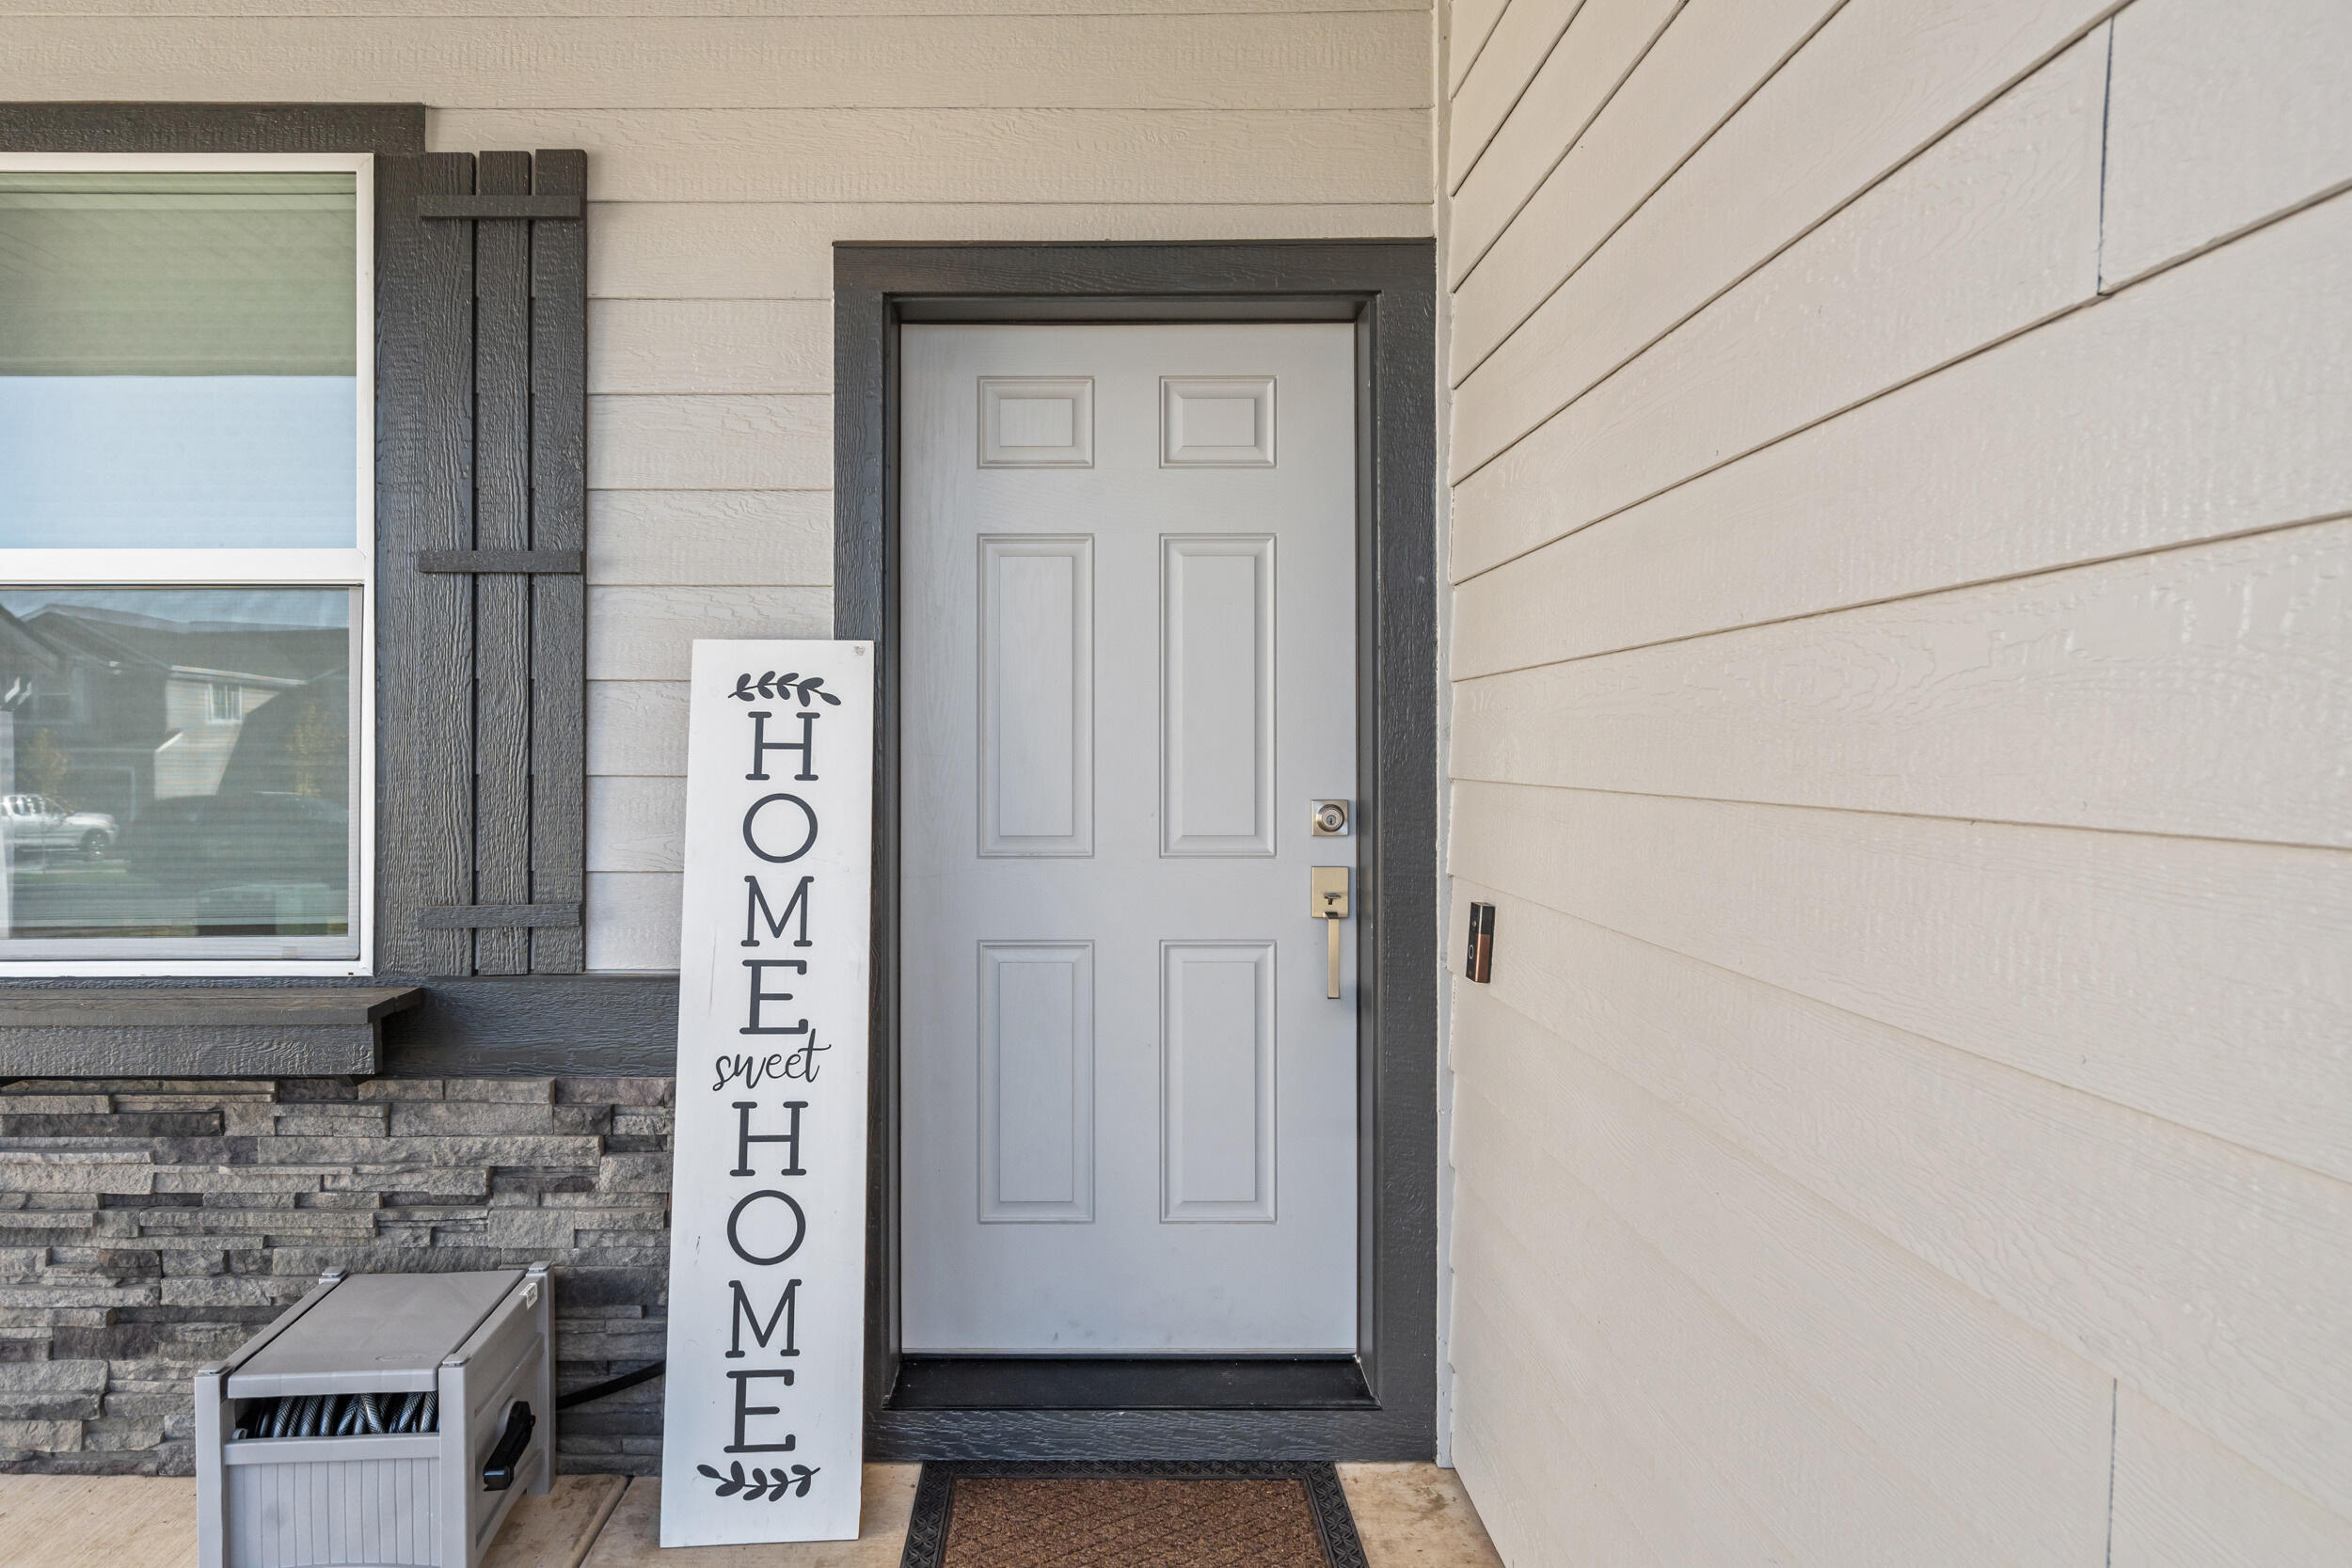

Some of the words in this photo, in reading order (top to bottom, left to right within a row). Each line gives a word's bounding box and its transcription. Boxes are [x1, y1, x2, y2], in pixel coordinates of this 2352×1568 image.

[739, 711, 821, 1035] HOME
[712, 1028, 832, 1092] sweet
[723, 1101, 809, 1454] HOME
